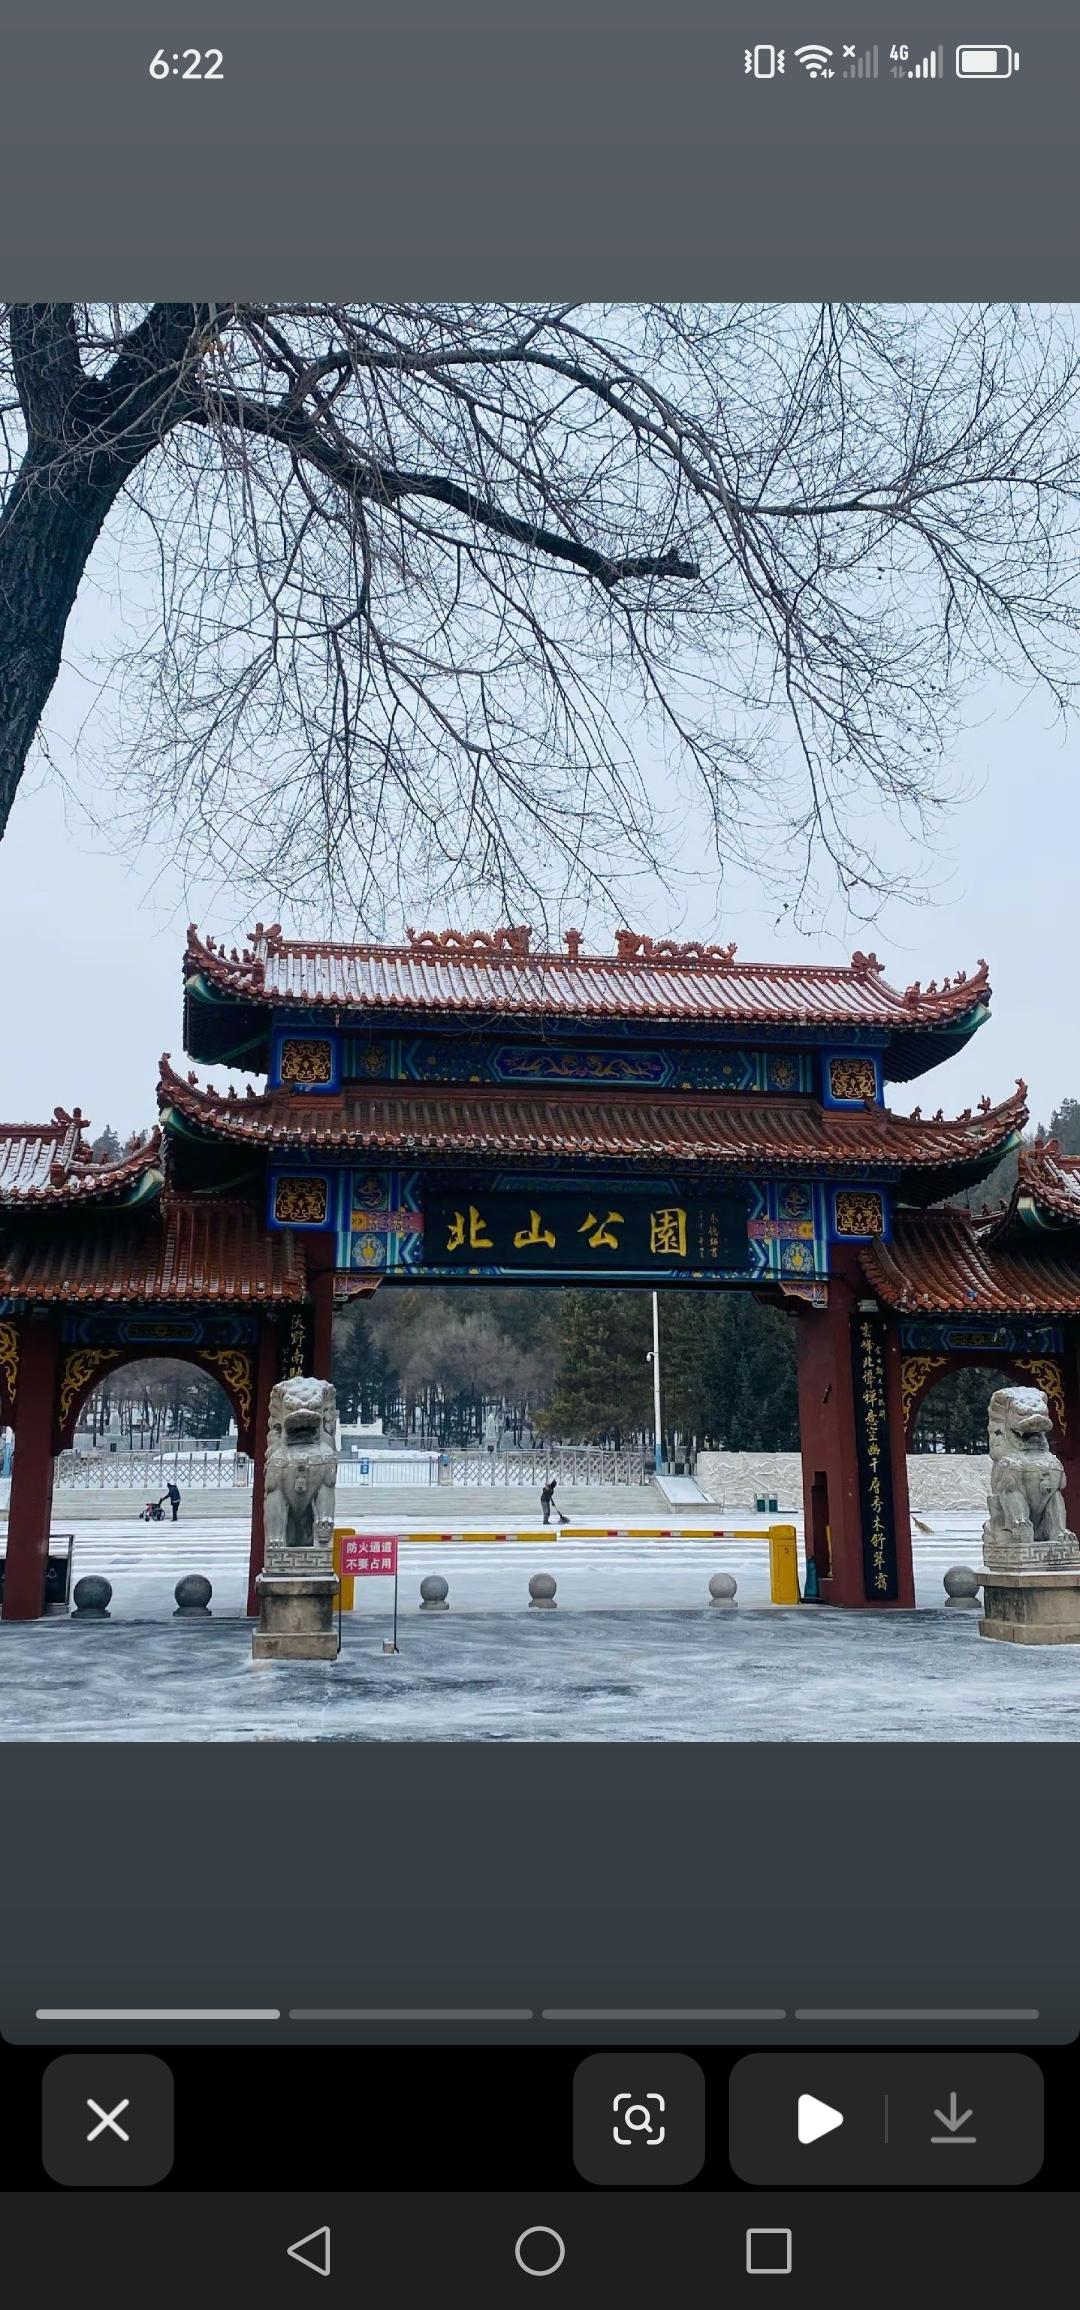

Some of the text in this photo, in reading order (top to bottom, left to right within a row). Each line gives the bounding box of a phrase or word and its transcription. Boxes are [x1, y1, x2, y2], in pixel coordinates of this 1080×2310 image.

[446, 1205, 687, 1257] 北山公園
[346, 1541, 392, 1554] 防火通道
[346, 1558, 392, 1571] 不要占用
